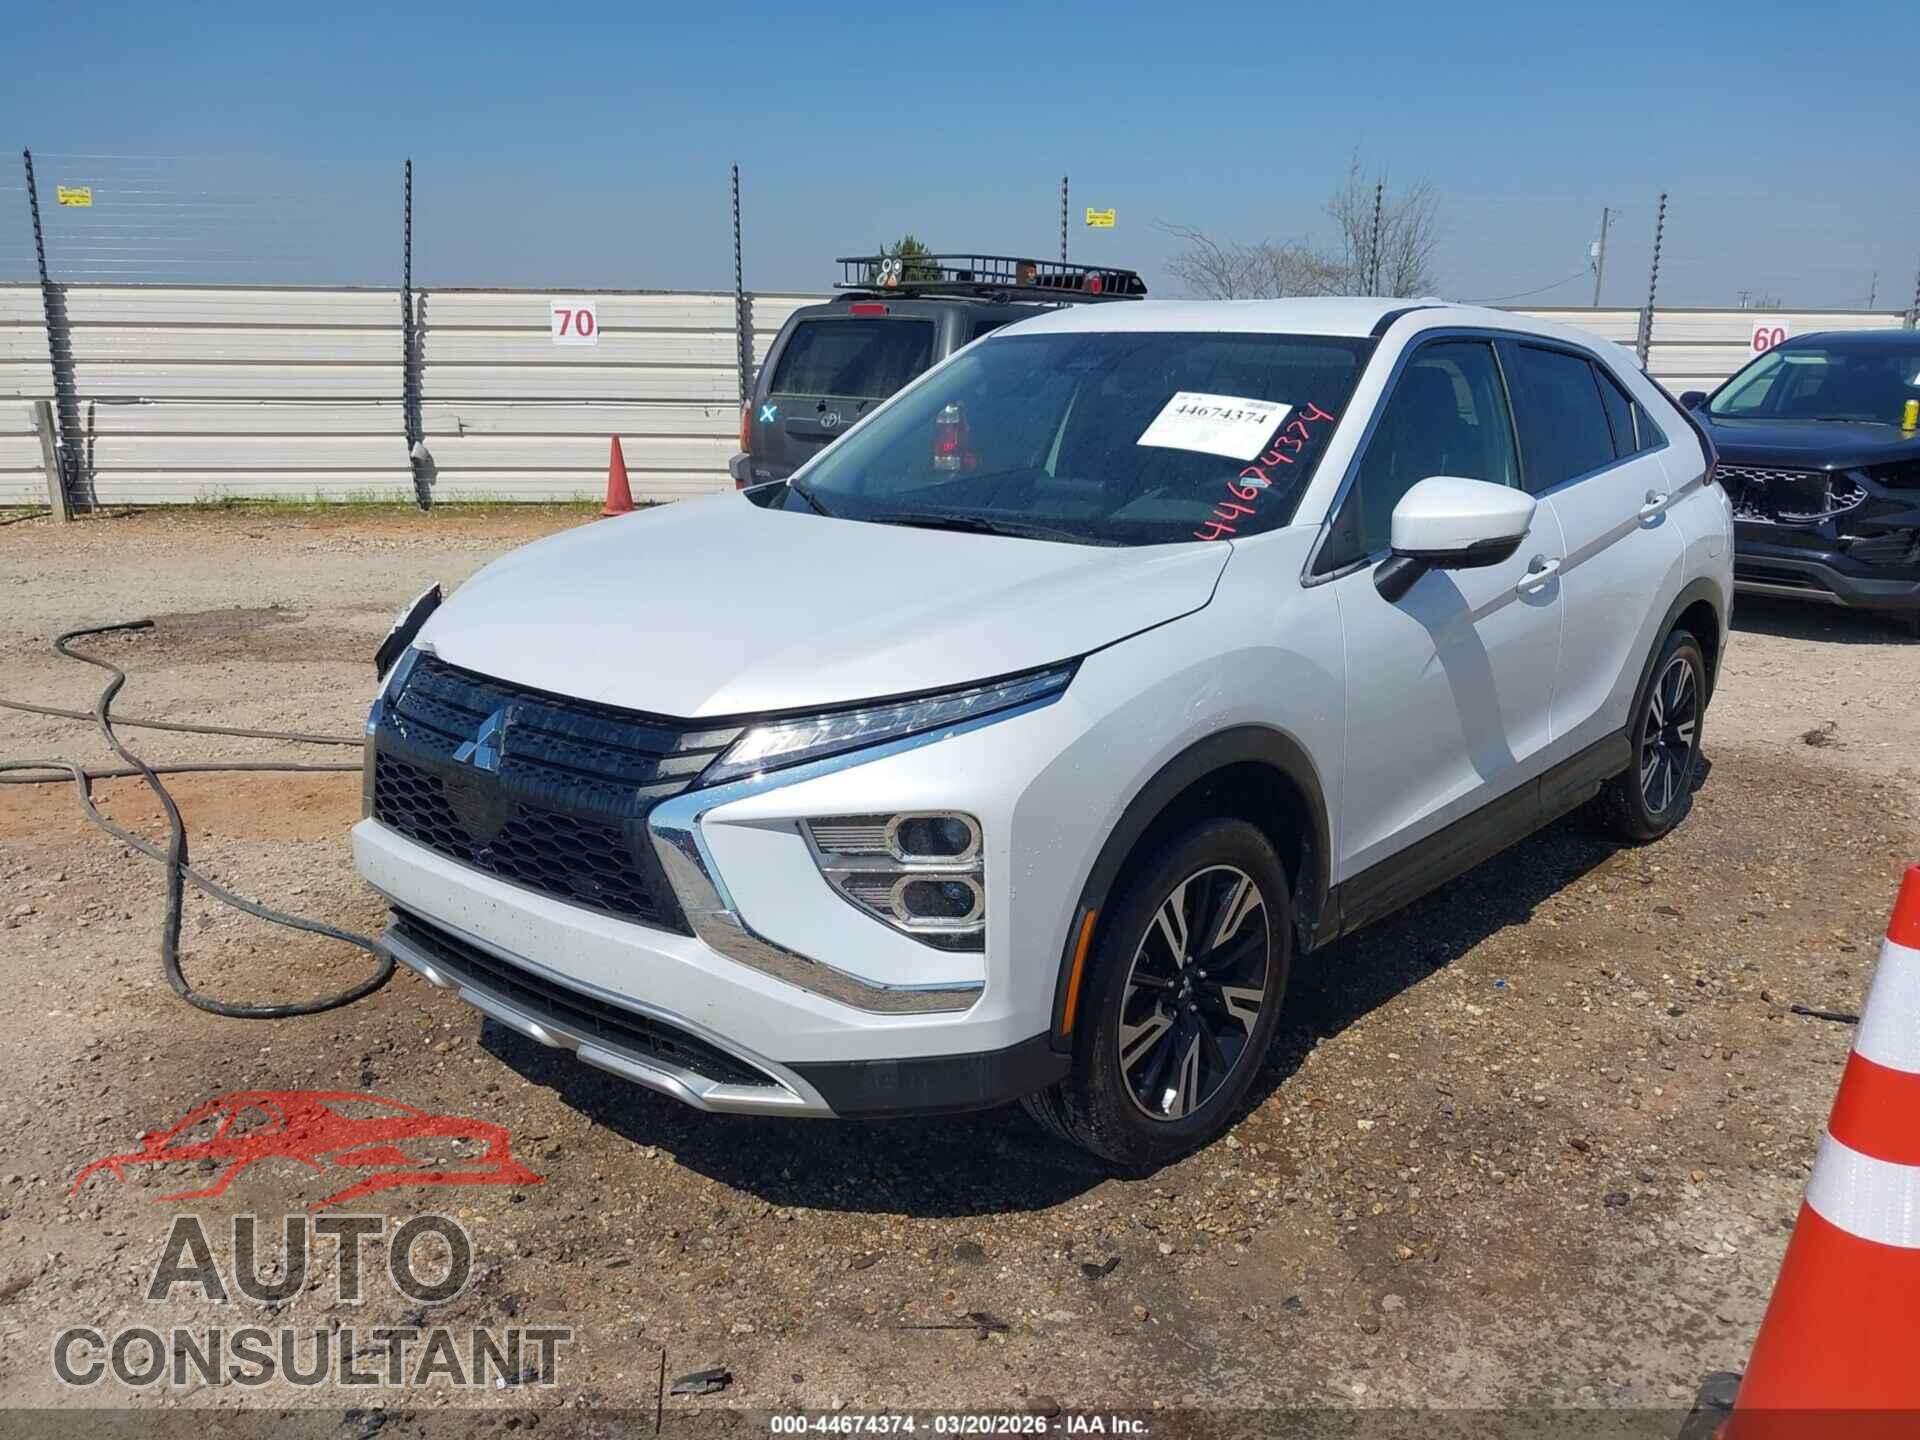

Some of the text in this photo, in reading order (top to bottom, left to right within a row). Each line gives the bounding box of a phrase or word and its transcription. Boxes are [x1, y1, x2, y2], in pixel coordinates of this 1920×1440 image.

[554, 309, 595, 337] 70
[1753, 327, 1786, 352] 60
[1176, 403, 1269, 425] 44674374
[1193, 401, 1335, 541] 44674374
